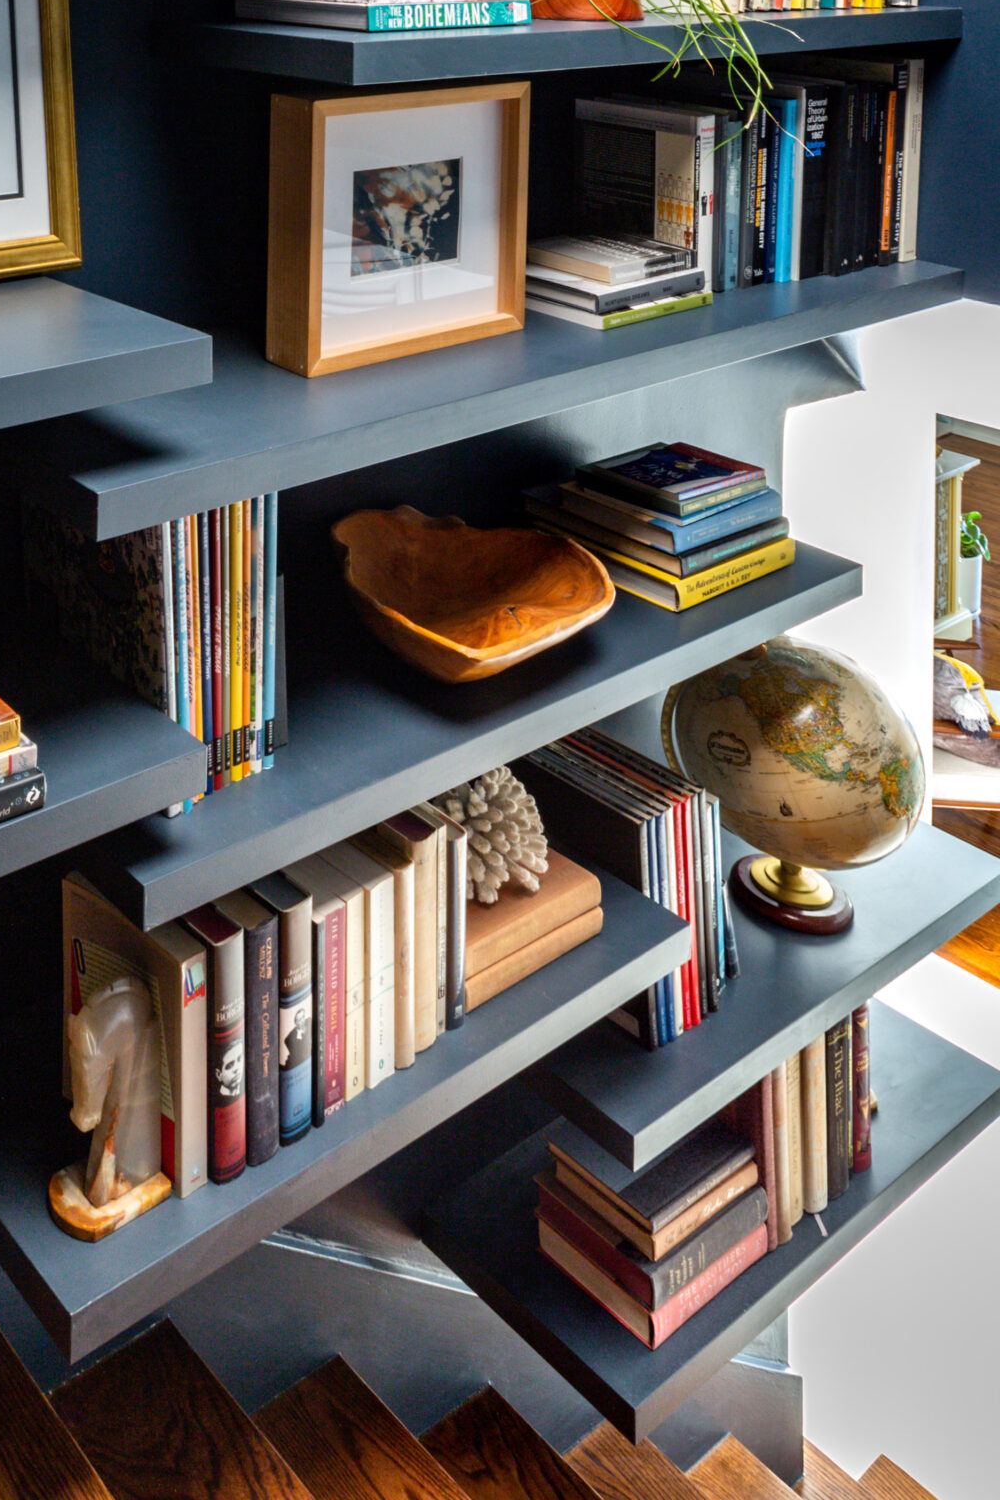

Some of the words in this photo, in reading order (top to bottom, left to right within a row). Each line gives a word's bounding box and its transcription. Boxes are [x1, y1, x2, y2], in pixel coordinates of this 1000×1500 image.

[387, 18, 403, 29] NEW
[388, 6, 403, 17] THE
[403, 2, 491, 30] BOHEMIANS
[808, 98, 828, 107] General
[808, 107, 826, 116] Theory
[895, 170, 903, 221] Functional
[759, 201, 767, 231] MODERN
[758, 233, 766, 249] CITY
[893, 221, 901, 243] City
[330, 914, 339, 935] THE
[330, 946, 339, 989] AENEID
[330, 992, 339, 1033] VIRGIL
[833, 1045, 845, 1079] The
[832, 1080, 844, 1117] Iliad
